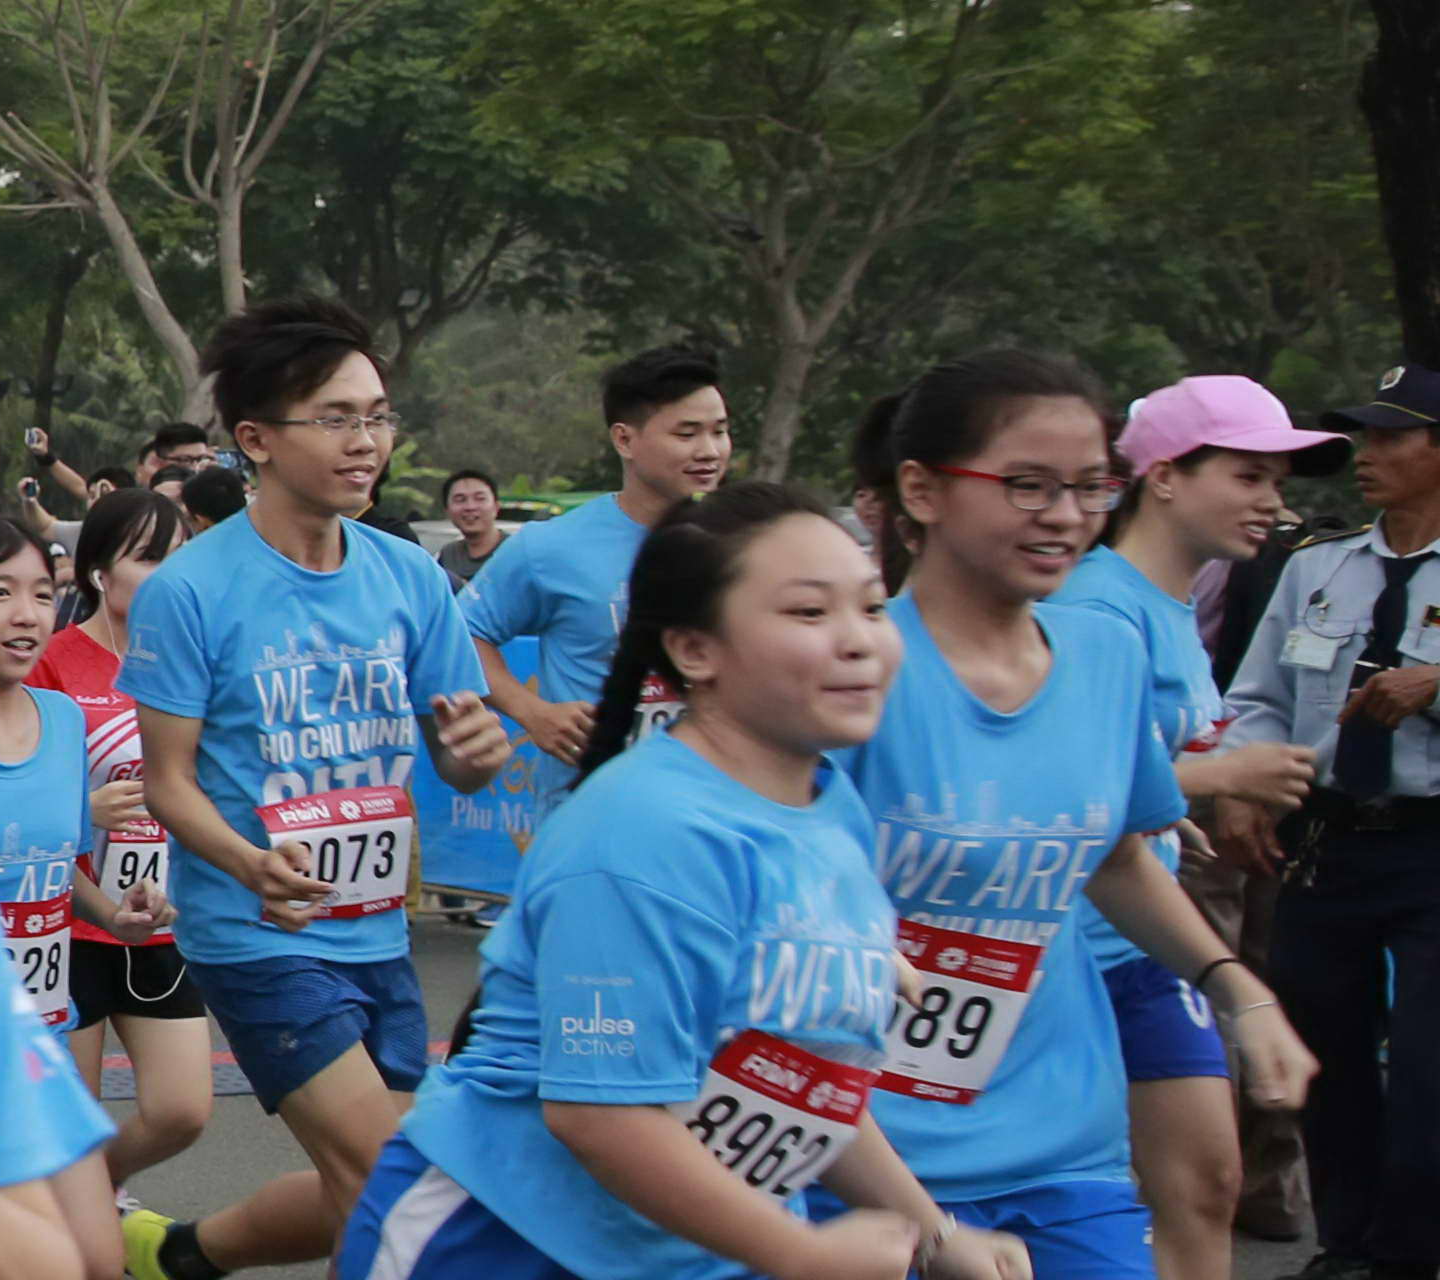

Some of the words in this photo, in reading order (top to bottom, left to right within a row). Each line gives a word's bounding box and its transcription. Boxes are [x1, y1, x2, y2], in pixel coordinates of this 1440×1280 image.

[253, 663, 322, 726] WE
[330, 656, 412, 716] ARE
[258, 730, 295, 764] HO
[300, 724, 344, 760] CHI
[348, 717, 415, 753] MINH
[451, 796, 493, 830] Phu
[874, 823, 984, 905] WE
[968, 839, 1106, 911] ARE
[561, 991, 635, 1036] pulse
[885, 986, 992, 1059] 89
[562, 1035, 635, 1056] active
[687, 1095, 830, 1197] 8962
